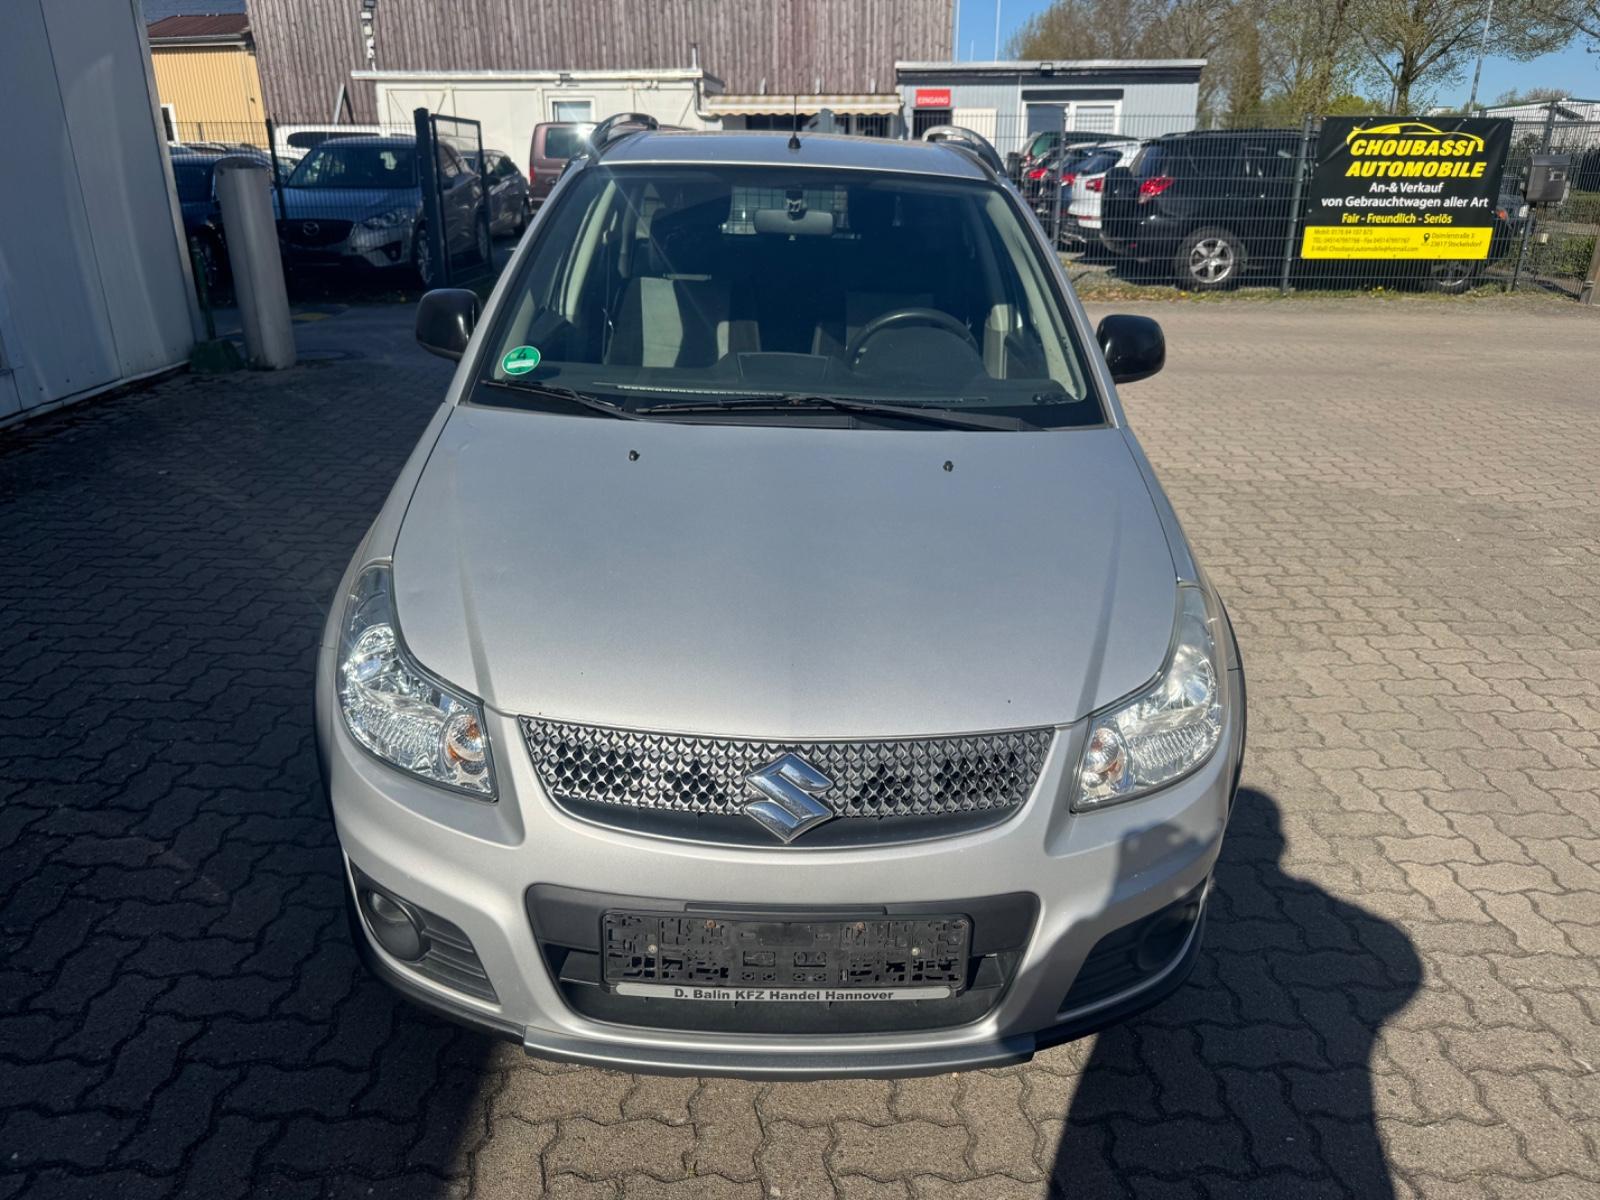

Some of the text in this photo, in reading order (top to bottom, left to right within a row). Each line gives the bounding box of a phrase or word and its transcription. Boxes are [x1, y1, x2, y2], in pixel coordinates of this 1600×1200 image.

[917, 96, 949, 104] EINGANG
[1350, 139, 1476, 157] CHOUBASSI
[1345, 161, 1487, 178] AUTOMOBILE
[1399, 182, 1444, 193] Verkauf
[1321, 196, 1489, 209] von Gebrauchtwagen aller Art
[1341, 213, 1360, 224] Fair
[1366, 213, 1416, 224] Freundlich
[1423, 213, 1453, 224] Seriös
[516, 348, 527, 359] 4
[674, 988, 894, 1001] D. Balin KFZ Handel Hannover
